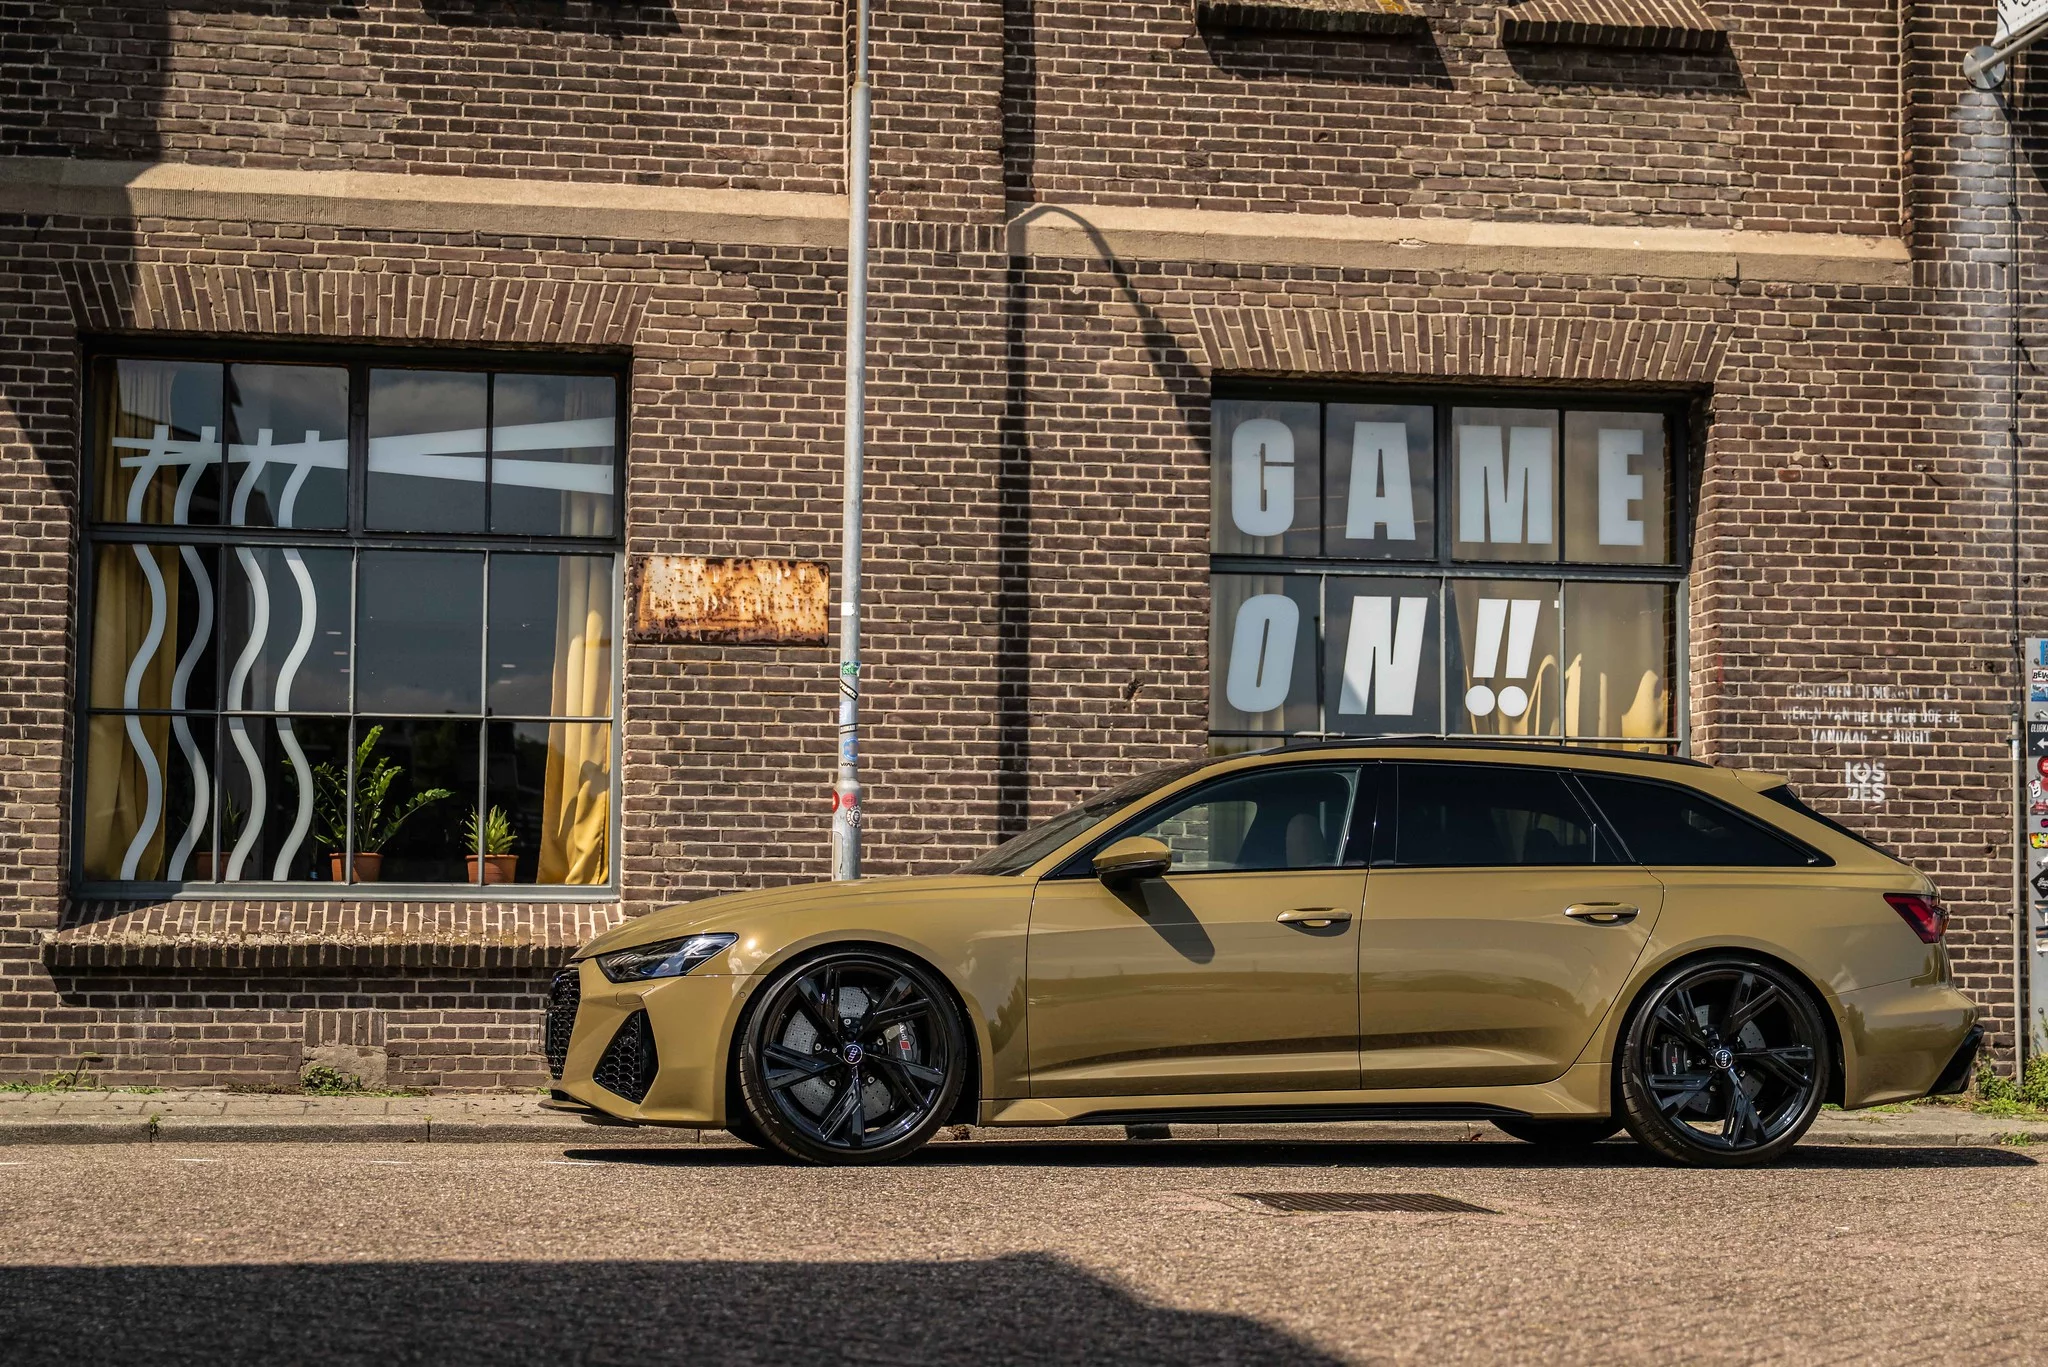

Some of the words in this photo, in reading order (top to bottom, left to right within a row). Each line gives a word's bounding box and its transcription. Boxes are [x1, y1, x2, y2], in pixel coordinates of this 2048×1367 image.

[1231, 418, 1645, 546] GAME
[1226, 593, 1541, 717] ON!!
[1811, 728, 1868, 743] VANDAAG
[1893, 730, 1932, 744] BIRGIT
